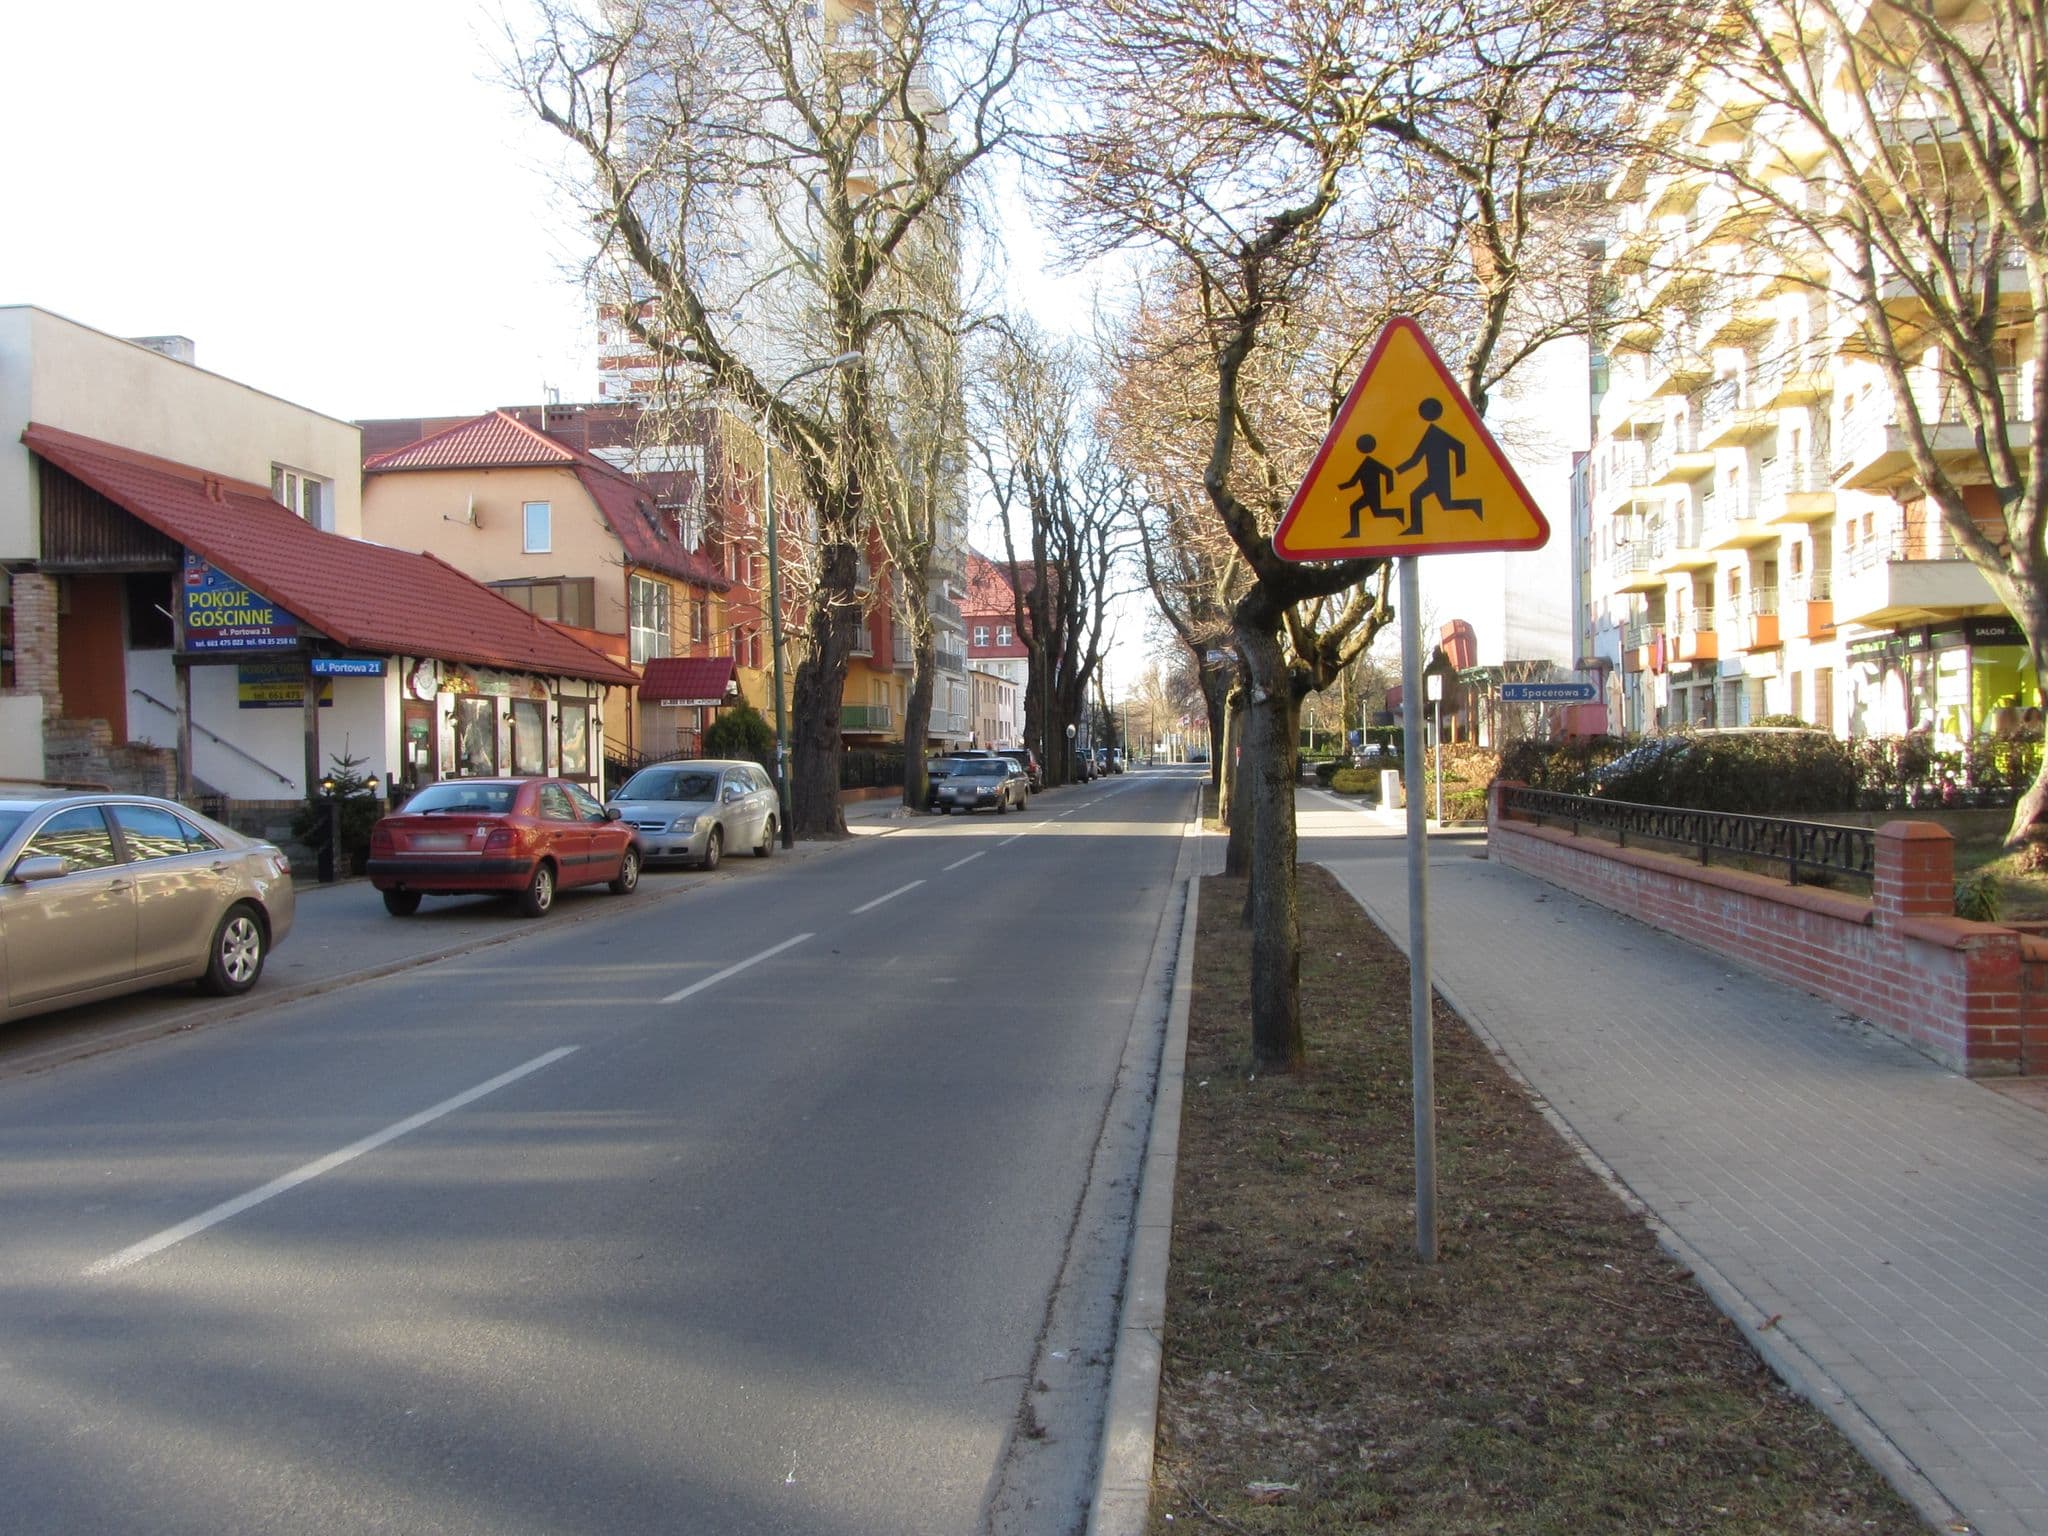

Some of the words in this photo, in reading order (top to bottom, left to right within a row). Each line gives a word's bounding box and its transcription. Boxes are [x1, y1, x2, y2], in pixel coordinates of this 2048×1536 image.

[189, 591, 250, 608] POKOJE
[189, 607, 273, 627] GOŚCINNE
[230, 628, 260, 636] Portowa
[262, 627, 271, 635] 21
[1975, 627, 2005, 636] SALON
[315, 664, 327, 672] ul.
[329, 663, 367, 673] Portowa
[369, 663, 380, 673] 21
[1505, 688, 1517, 697] ul.
[1522, 688, 1579, 698] Spacerowa
[1583, 688, 1590, 697] 2
